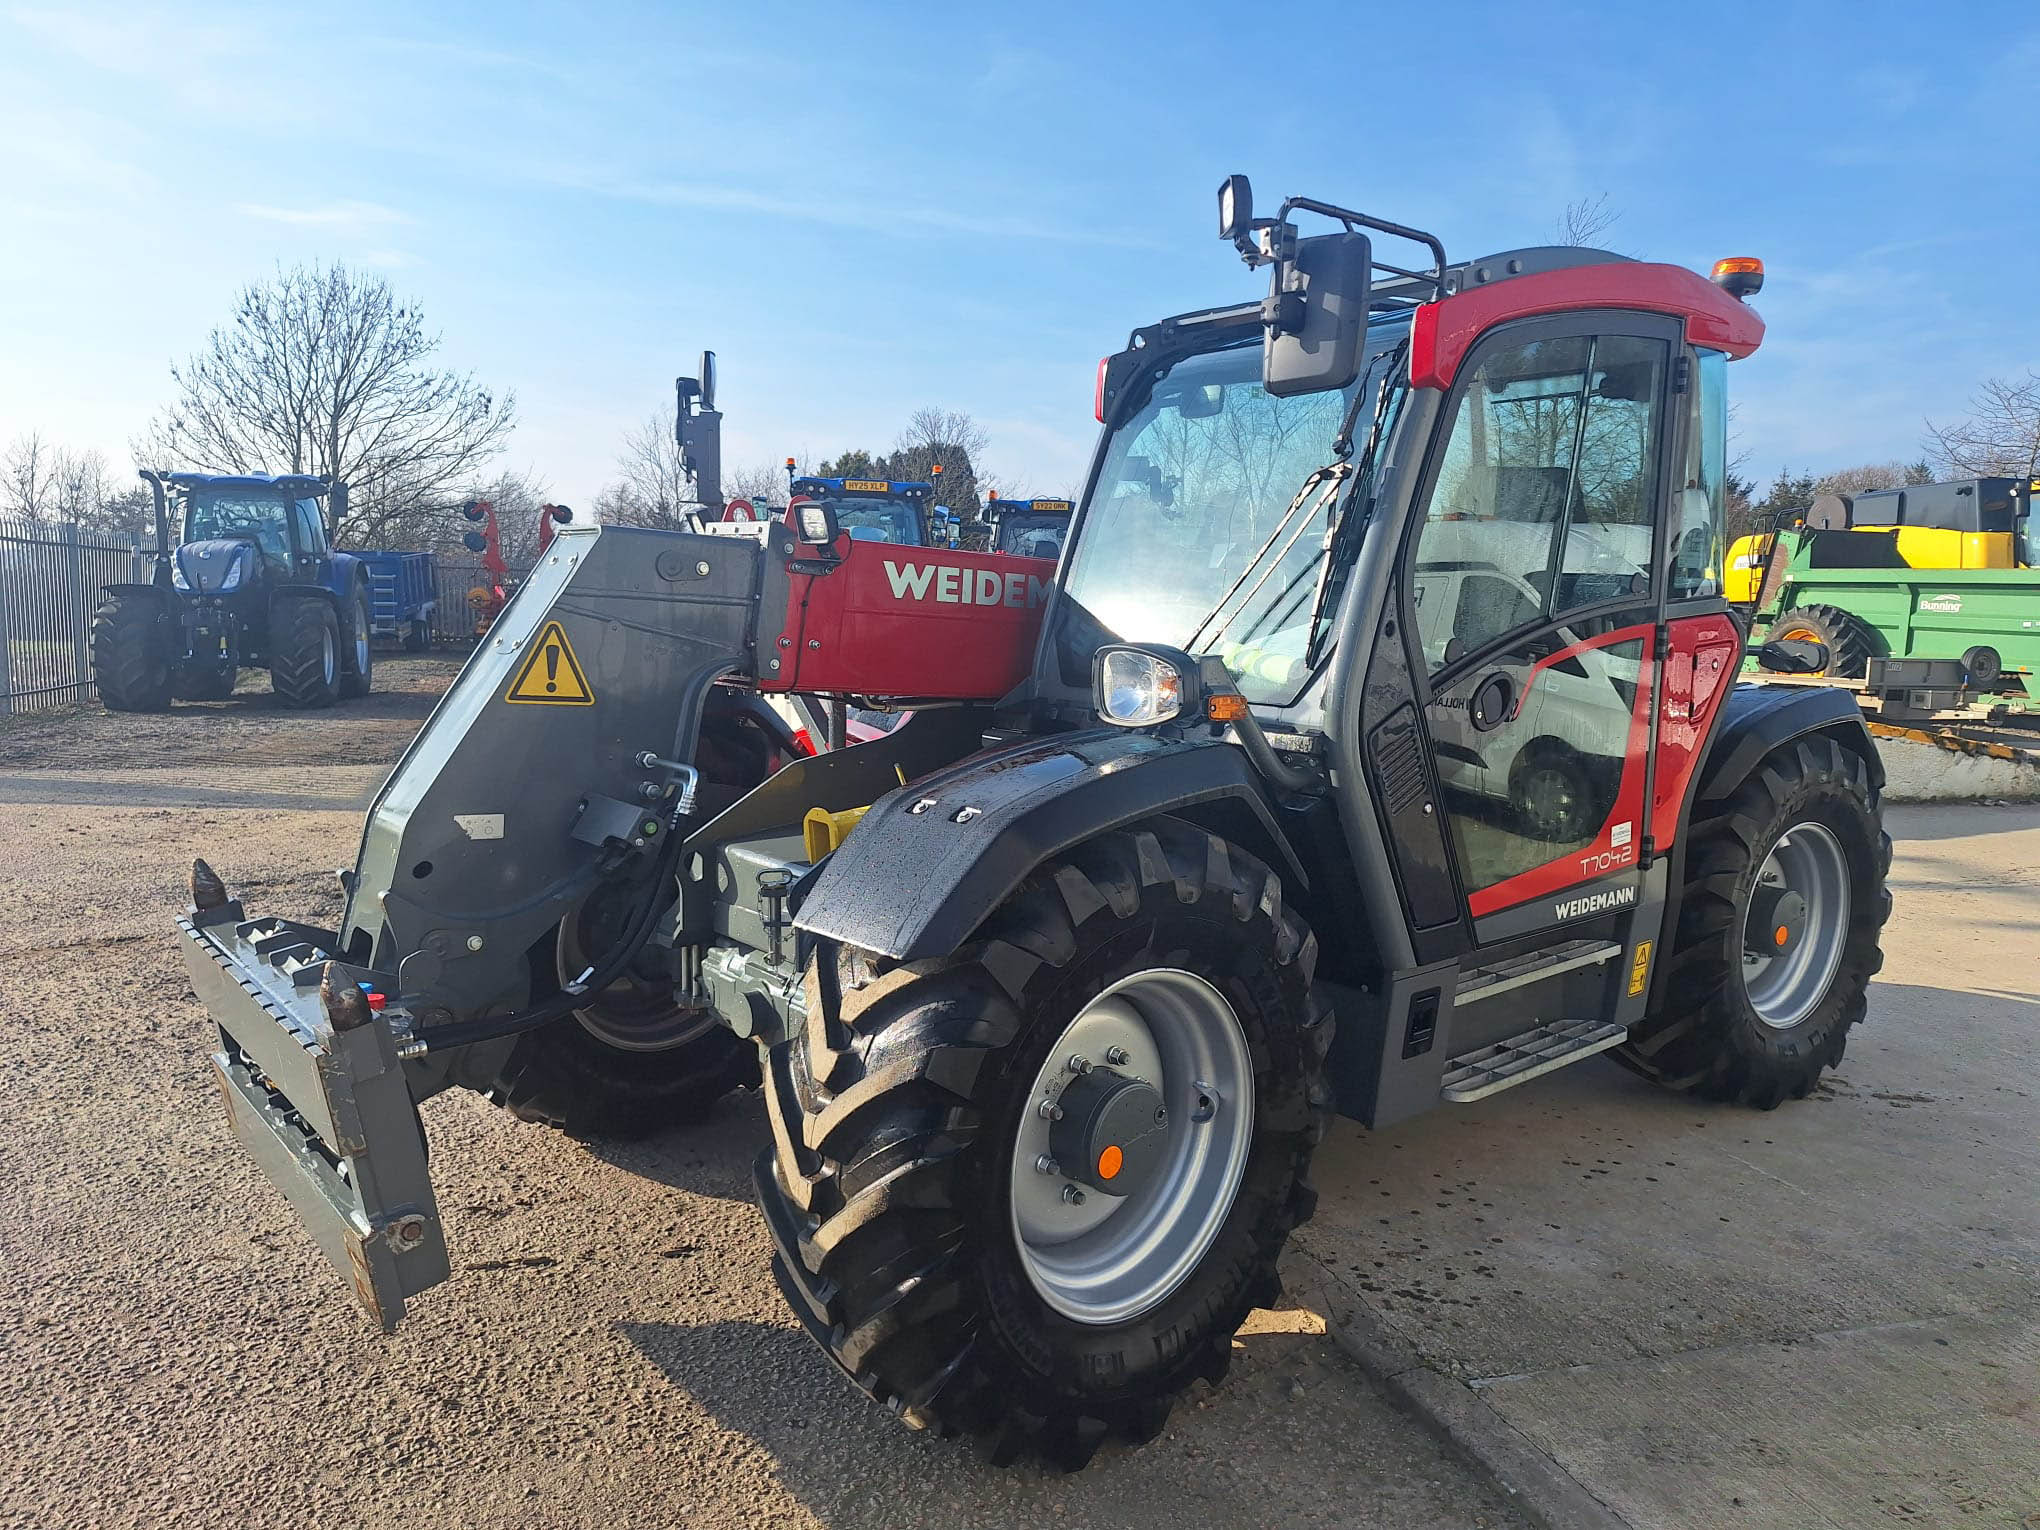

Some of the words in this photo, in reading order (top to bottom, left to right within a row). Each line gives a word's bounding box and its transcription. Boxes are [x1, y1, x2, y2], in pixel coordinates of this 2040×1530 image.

[848, 481, 869, 490] HY25
[870, 482, 886, 491] XLP
[883, 560, 1055, 609] WEIDEM
[1920, 600, 1962, 613] Bunning
[1580, 845, 1632, 876] T7042
[1555, 886, 1635, 920] WEIDEMANN
